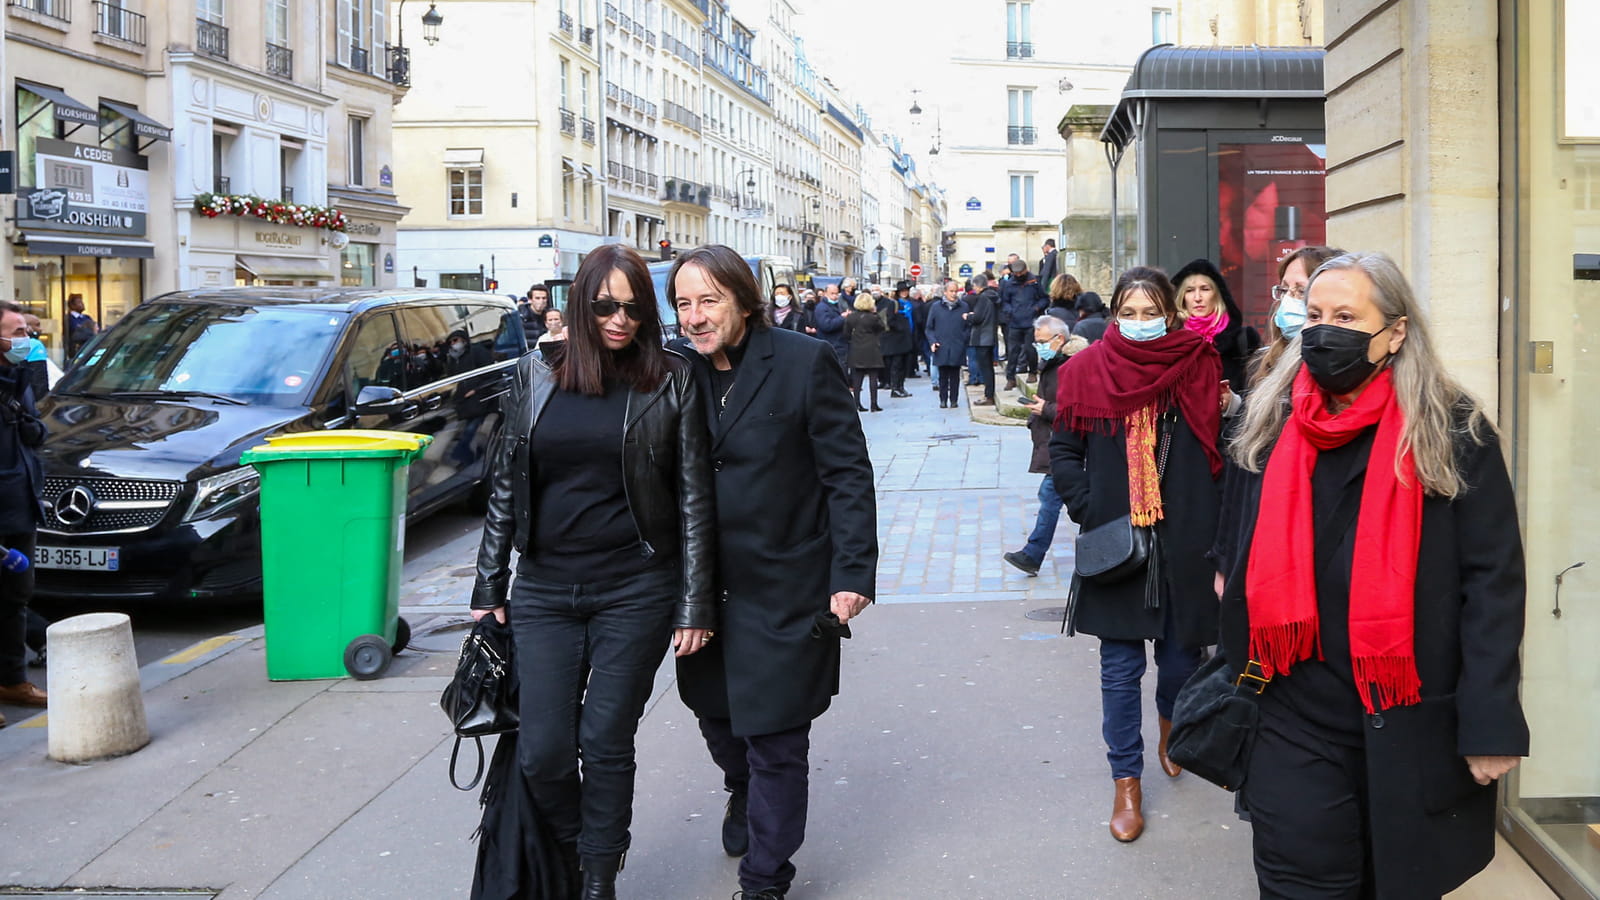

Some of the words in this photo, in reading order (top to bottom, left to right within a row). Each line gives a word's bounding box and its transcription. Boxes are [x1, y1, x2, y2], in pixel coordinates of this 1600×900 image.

[57, 106, 97, 121] FLORSHEIM
[137, 123, 169, 137] FLORSHEIM
[74, 145, 82, 158] A
[83, 148, 113, 163] CEDER
[57, 211, 121, 228] ORSHEIM
[78, 246, 112, 255] FLORSHEIM
